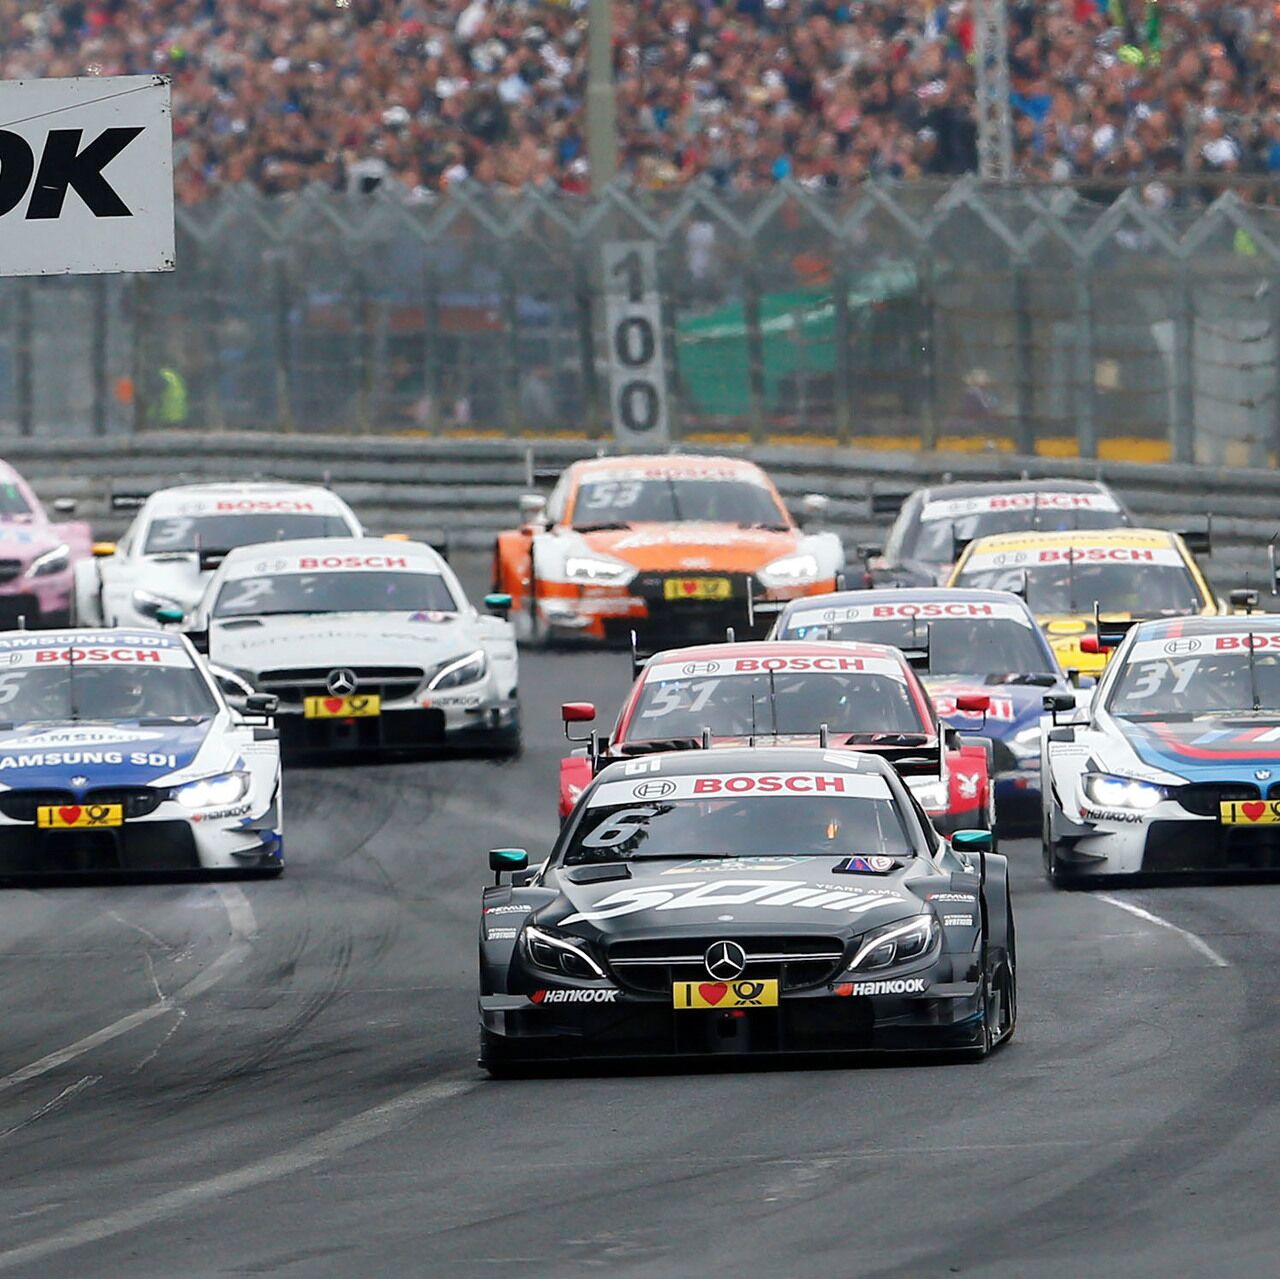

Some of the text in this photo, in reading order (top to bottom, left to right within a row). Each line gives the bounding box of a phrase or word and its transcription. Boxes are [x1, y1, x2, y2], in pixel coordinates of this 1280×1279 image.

[586, 481, 644, 509] 53
[989, 495, 1092, 509] BOSCH
[216, 500, 314, 511] BOSCH
[152, 519, 194, 545] 3
[298, 556, 407, 570] BOSCH
[1038, 549, 1154, 563] BOSCH
[222, 578, 275, 609] 2
[872, 604, 993, 618] BOSCH
[125, 636, 169, 648] SDI
[35, 649, 161, 664] BOSCH
[735, 658, 865, 671] BOSCH
[1126, 659, 1201, 700] 31
[641, 679, 721, 719] 51
[131, 751, 177, 769] SDI
[693, 776, 846, 795] BOSCH
[581, 808, 658, 848] 6
